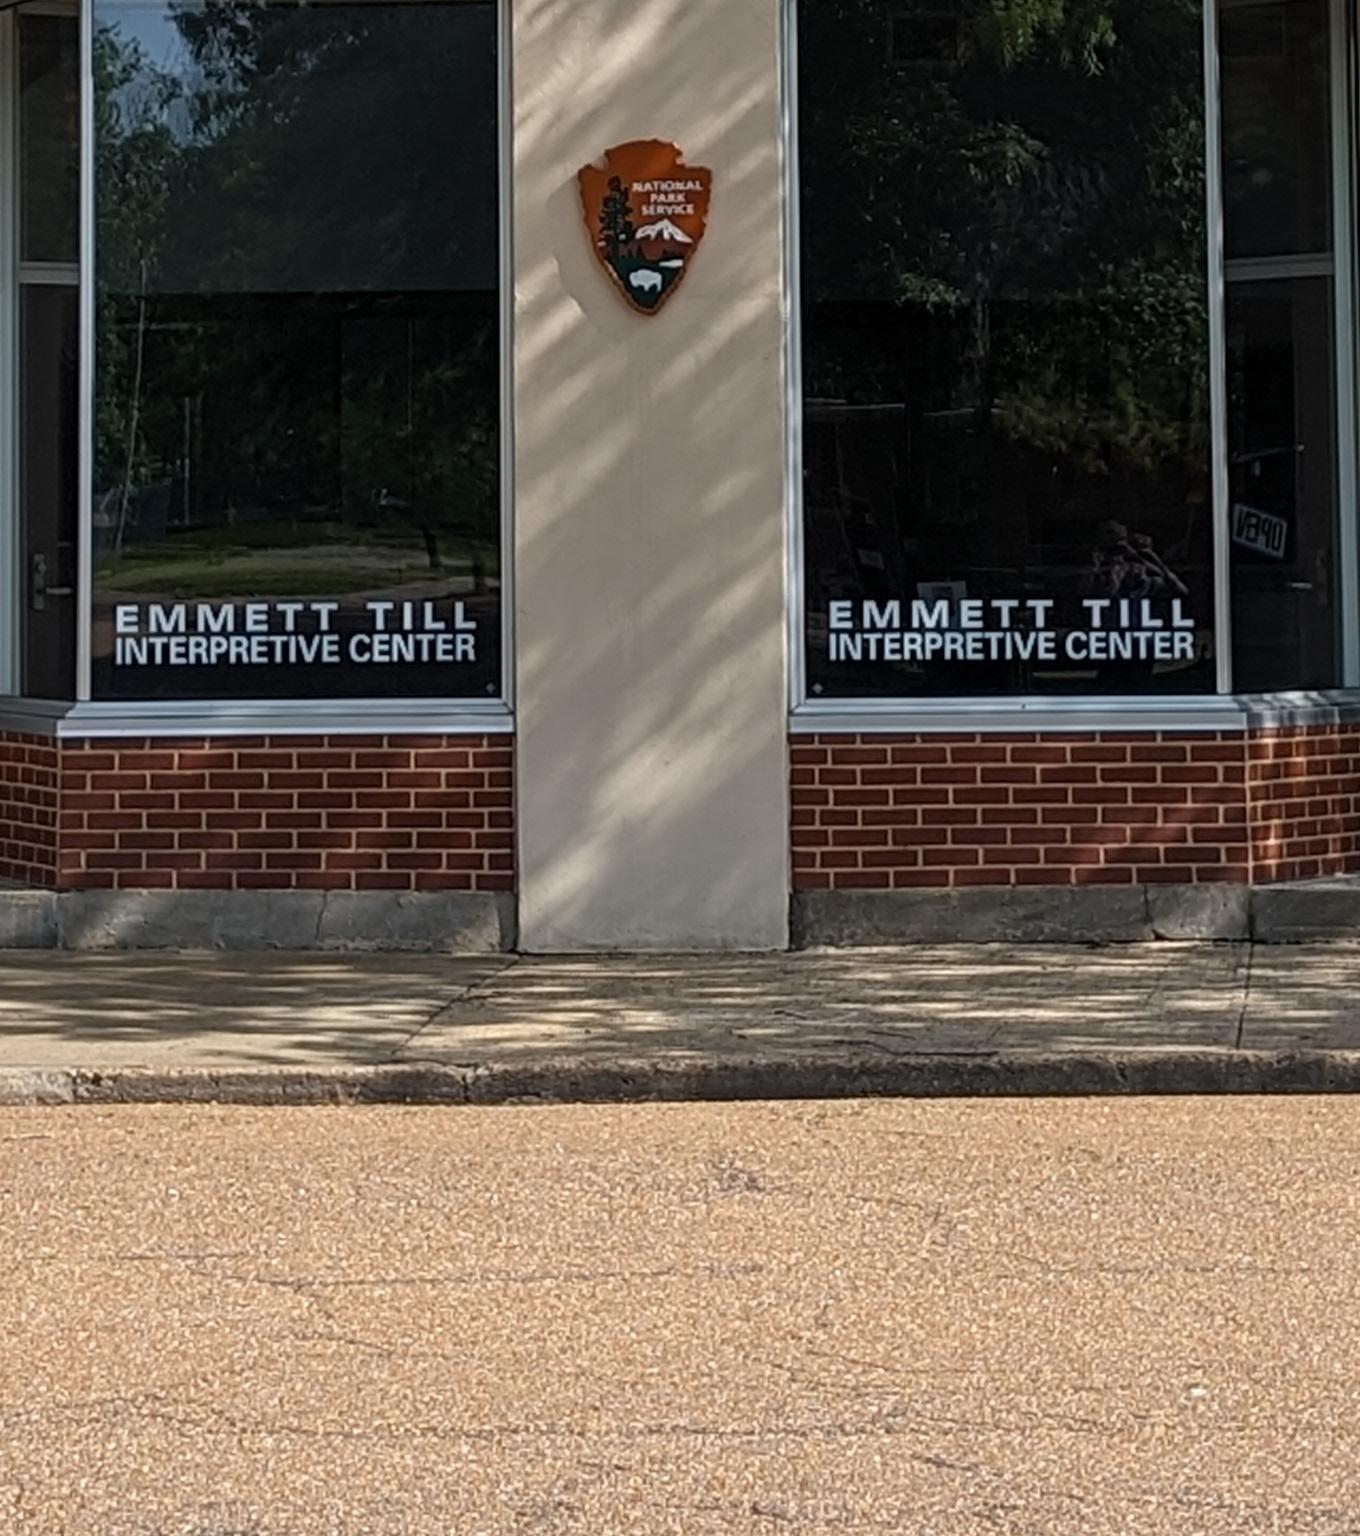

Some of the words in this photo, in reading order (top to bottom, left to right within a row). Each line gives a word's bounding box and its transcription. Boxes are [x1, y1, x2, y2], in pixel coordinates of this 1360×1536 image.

[632, 180, 703, 192] NATIONAL
[650, 193, 686, 203] PARK
[641, 204, 695, 215] SERVICE
[115, 601, 340, 634] EMMETT
[365, 600, 478, 631] TILL
[828, 599, 1055, 629] EMMETT
[1082, 598, 1195, 628] TILL
[115, 634, 340, 666] INTERPRETIVE
[349, 633, 476, 663] CENTER
[828, 631, 1056, 662] INTERPRETIVE
[1065, 630, 1195, 660] CENTER
